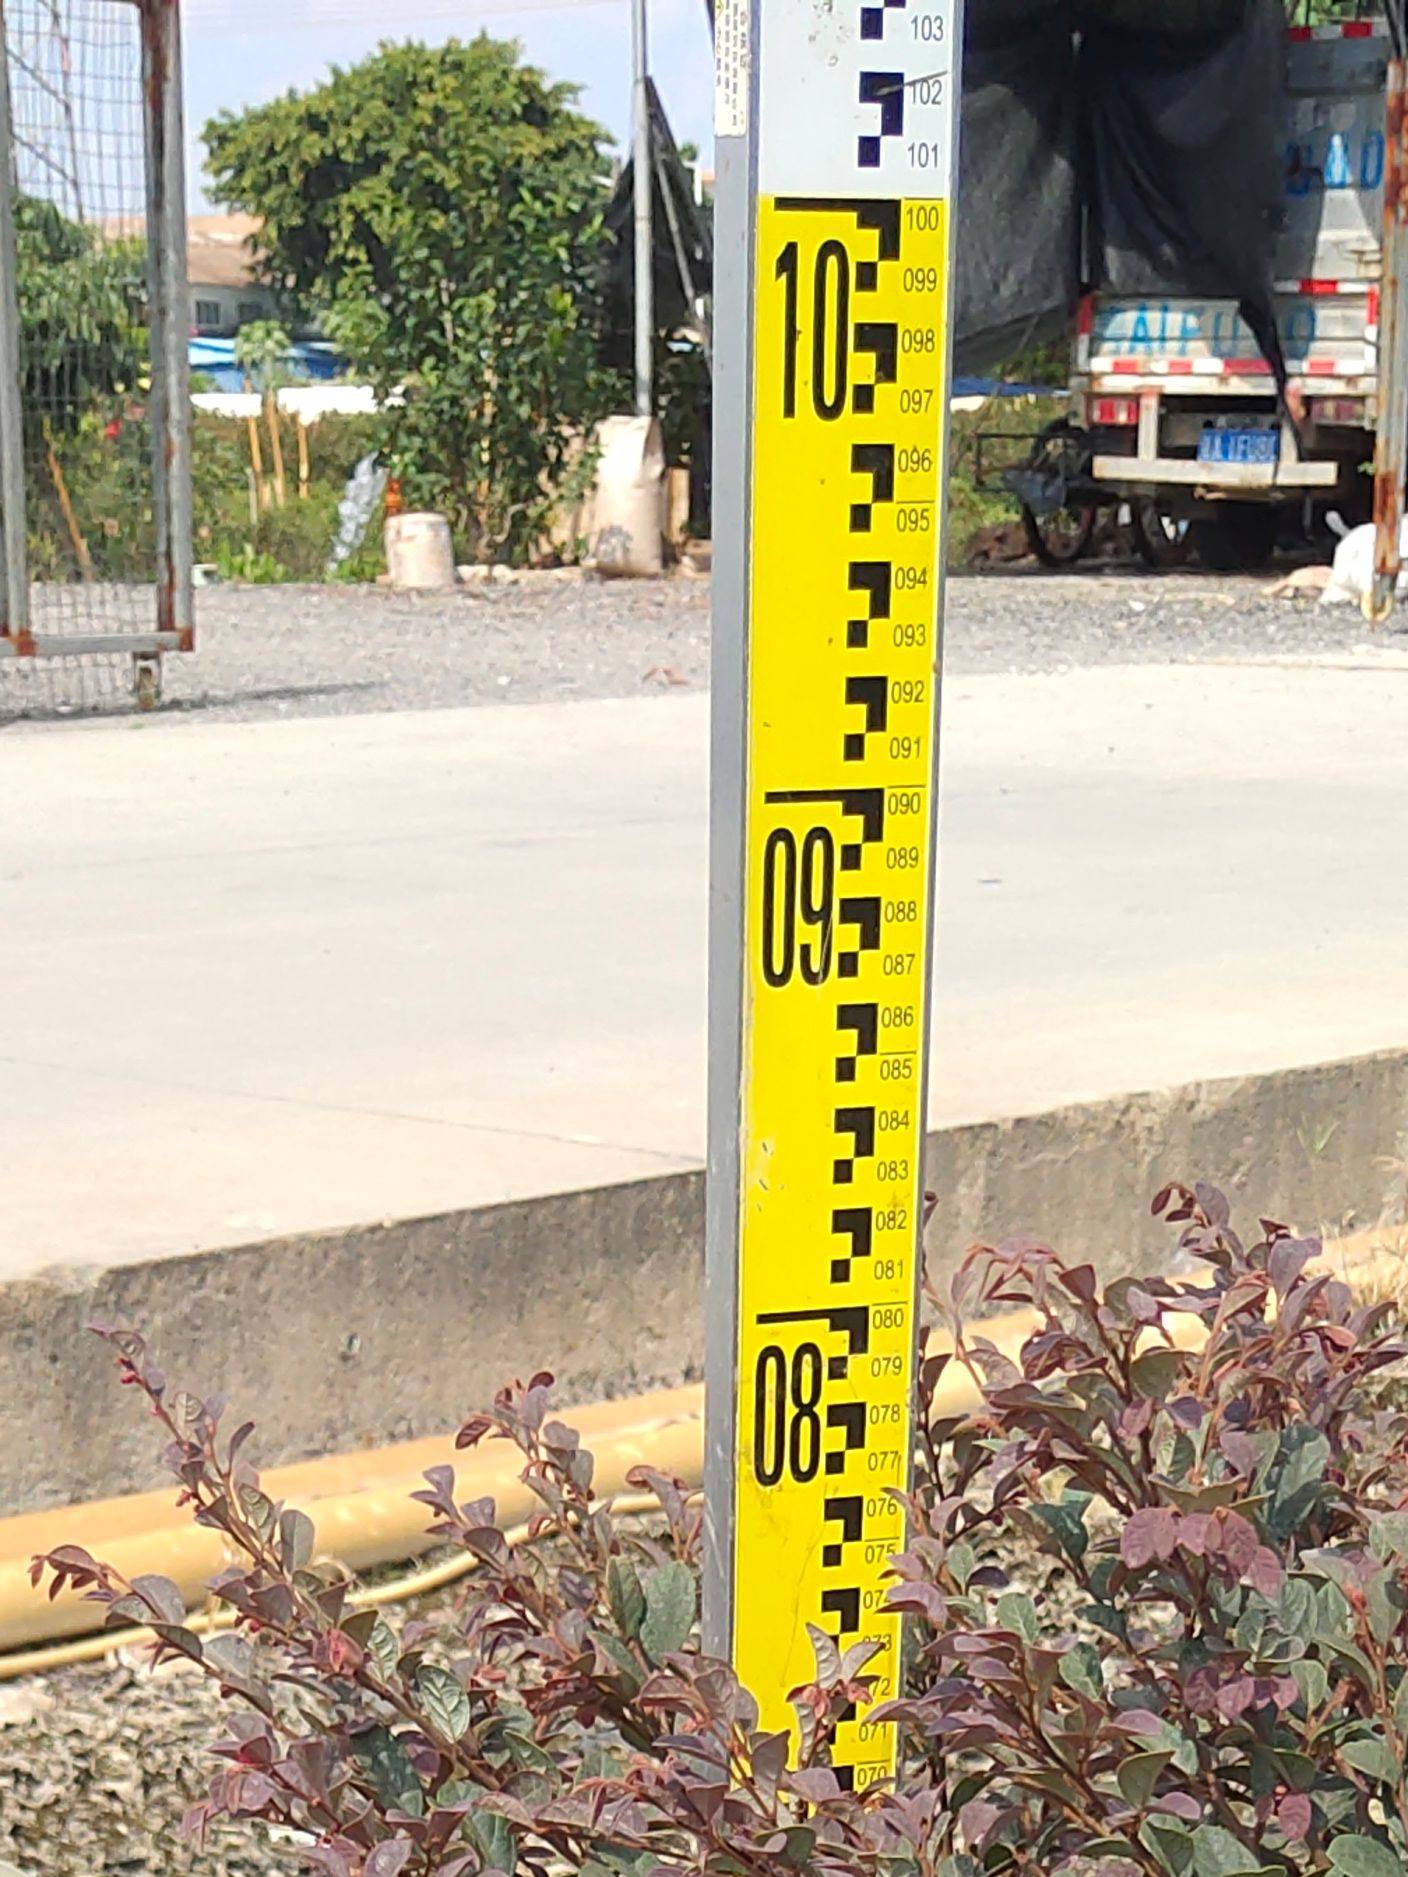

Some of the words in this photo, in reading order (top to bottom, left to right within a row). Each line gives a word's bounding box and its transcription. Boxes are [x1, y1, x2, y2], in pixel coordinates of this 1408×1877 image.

[911, 15, 944, 41] 103
[911, 79, 942, 105] 102
[907, 143, 939, 168] 101
[906, 206, 939, 231] 100
[903, 268, 937, 292] 099
[774, 239, 850, 422] 10
[901, 329, 935, 354] 098
[900, 389, 933, 414] 097
[898, 449, 932, 473] 096
[896, 509, 930, 533] 095
[894, 567, 928, 590] 094
[893, 624, 926, 647] 093
[891, 681, 924, 704] 092
[889, 737, 921, 759] 091
[888, 792, 920, 815] 090
[886, 847, 919, 869] 089
[762, 826, 834, 988] 09
[884, 901, 917, 922] 088
[883, 954, 916, 976] 087
[881, 1007, 914, 1028] 086
[880, 1059, 912, 1080] 085
[878, 1110, 910, 1131] 084
[877, 1161, 909, 1181] 083
[875, 1210, 907, 1230] 082
[874, 1259, 904, 1280] 081
[872, 1308, 904, 1328] 080
[871, 1357, 903, 1377] 079
[754, 1342, 822, 1487] 08
[869, 1405, 901, 1425] 078
[868, 1451, 898, 1471] 077
[866, 1498, 897, 1517] 076
